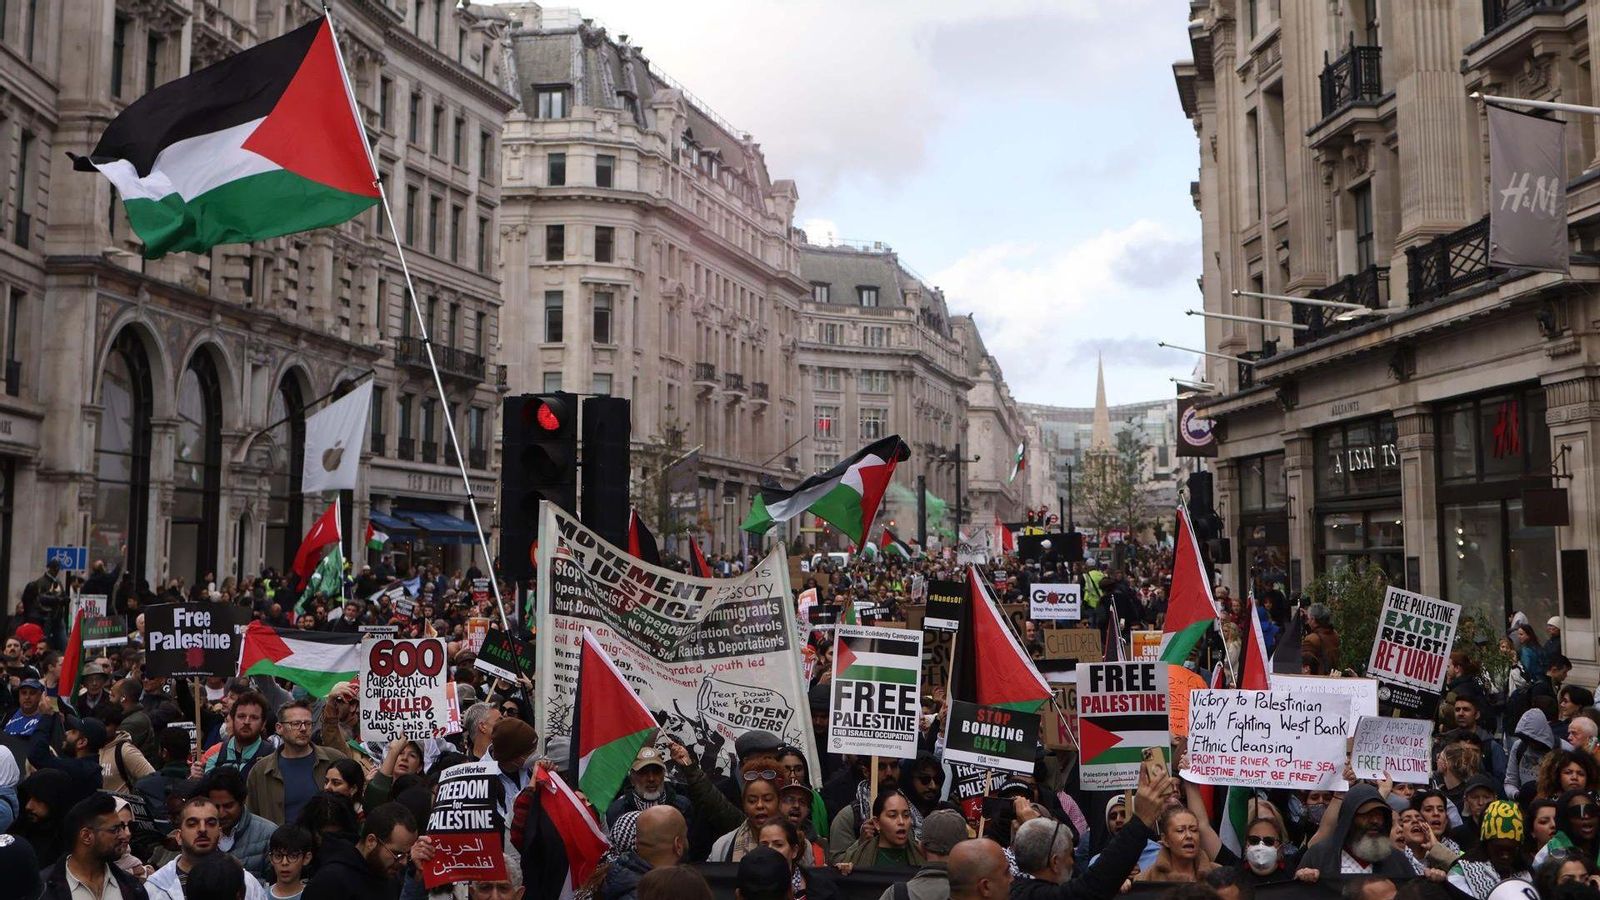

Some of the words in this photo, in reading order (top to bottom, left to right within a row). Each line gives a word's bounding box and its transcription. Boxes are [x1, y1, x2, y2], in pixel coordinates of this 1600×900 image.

[1500, 171, 1560, 218] H&M
[555, 513, 712, 602] MOVEMENT
[555, 559, 581, 583] Stop
[709, 602, 781, 623] Immigrants
[587, 558, 704, 622] JUSTICE
[172, 606, 212, 628] Free
[555, 581, 582, 598] Open
[628, 616, 642, 633] No
[643, 629, 671, 648] More
[732, 620, 783, 638] Controls
[1388, 591, 1411, 612] FREE
[1410, 597, 1455, 624] PALESTINE
[554, 596, 575, 612] Shut
[575, 600, 602, 619] Down
[678, 642, 706, 658] Raids
[709, 639, 717, 654] &
[718, 633, 785, 655] Deportation's
[1384, 609, 1452, 641] EXIST!
[148, 629, 231, 651] Palestine
[573, 637, 582, 647] &
[838, 628, 864, 638] Palestine
[864, 629, 891, 640] Solidarity
[892, 632, 920, 643] Campaign
[1046, 632, 1101, 655] CHILDREN
[1381, 626, 1447, 656] RESIST!
[369, 638, 445, 678] 600
[596, 628, 610, 638] an
[711, 659, 743, 674] youth
[748, 657, 766, 669] led
[1373, 639, 1444, 685] RETURN!
[366, 670, 440, 689] Palestinian
[1089, 663, 1157, 693] FREE
[365, 688, 417, 699] CHILDREN
[712, 691, 736, 699] Tear
[743, 690, 775, 698] Down
[712, 700, 729, 709] the
[734, 697, 771, 708] fences
[833, 679, 917, 717] FREE
[1080, 693, 1167, 714] PALESTINE
[1392, 689, 1422, 701] PALESTINE
[1392, 694, 1423, 706] SOLIDARITY
[362, 709, 371, 720] BY
[375, 711, 408, 721] ISREAL
[410, 711, 420, 719] IN
[425, 706, 434, 720] 6
[379, 695, 433, 713] KILLED
[709, 707, 725, 719] the
[740, 705, 789, 720] OPEN
[1191, 690, 1230, 719] Victory
[1236, 691, 1247, 706] to
[1255, 691, 1322, 713] Palestinian
[1391, 698, 1419, 710] CAMPAIGN
[402, 720, 424, 731] this
[727, 712, 784, 732] BORDERS
[832, 711, 916, 732] PALESTINE
[975, 709, 1012, 727] STOP
[1190, 709, 1216, 731] Youth
[1227, 711, 1271, 739] Fighting
[1280, 714, 1311, 734] West
[1314, 716, 1348, 736] Bank
[1361, 720, 1380, 731] STOP
[1386, 721, 1425, 736] APARTHEID
[833, 729, 847, 737] END
[848, 730, 874, 739] ISRAELI
[874, 732, 914, 742] OCCUPATION
[961, 719, 1025, 743] BOMBING
[1360, 732, 1380, 743] STOP
[1382, 734, 1425, 749] GENOCIDE
[973, 735, 1007, 753] GAZA
[1356, 742, 1380, 754] STOP
[444, 767, 466, 779] Socialist
[466, 764, 488, 776] Worker
[1083, 770, 1108, 779] Palestine
[1109, 769, 1127, 778] Forum
[1190, 765, 1235, 778] PALESTINE
[1239, 769, 1266, 779] MUST
[1271, 771, 1284, 781] BE
[1191, 754, 1215, 766] FROM
[1219, 755, 1236, 767] THE
[1240, 756, 1269, 768] RIVER
[1275, 758, 1289, 768] TO
[1292, 759, 1313, 770] THE
[1315, 761, 1337, 775] SEA,
[1357, 755, 1382, 771] FREE
[1384, 756, 1429, 773] PALESTINE
[435, 779, 489, 803] FREEDOM
[451, 799, 463, 810] for
[426, 809, 495, 831] PALESTINE
[434, 837, 485, 857] الحرية
[432, 855, 495, 876] لفلسطين
